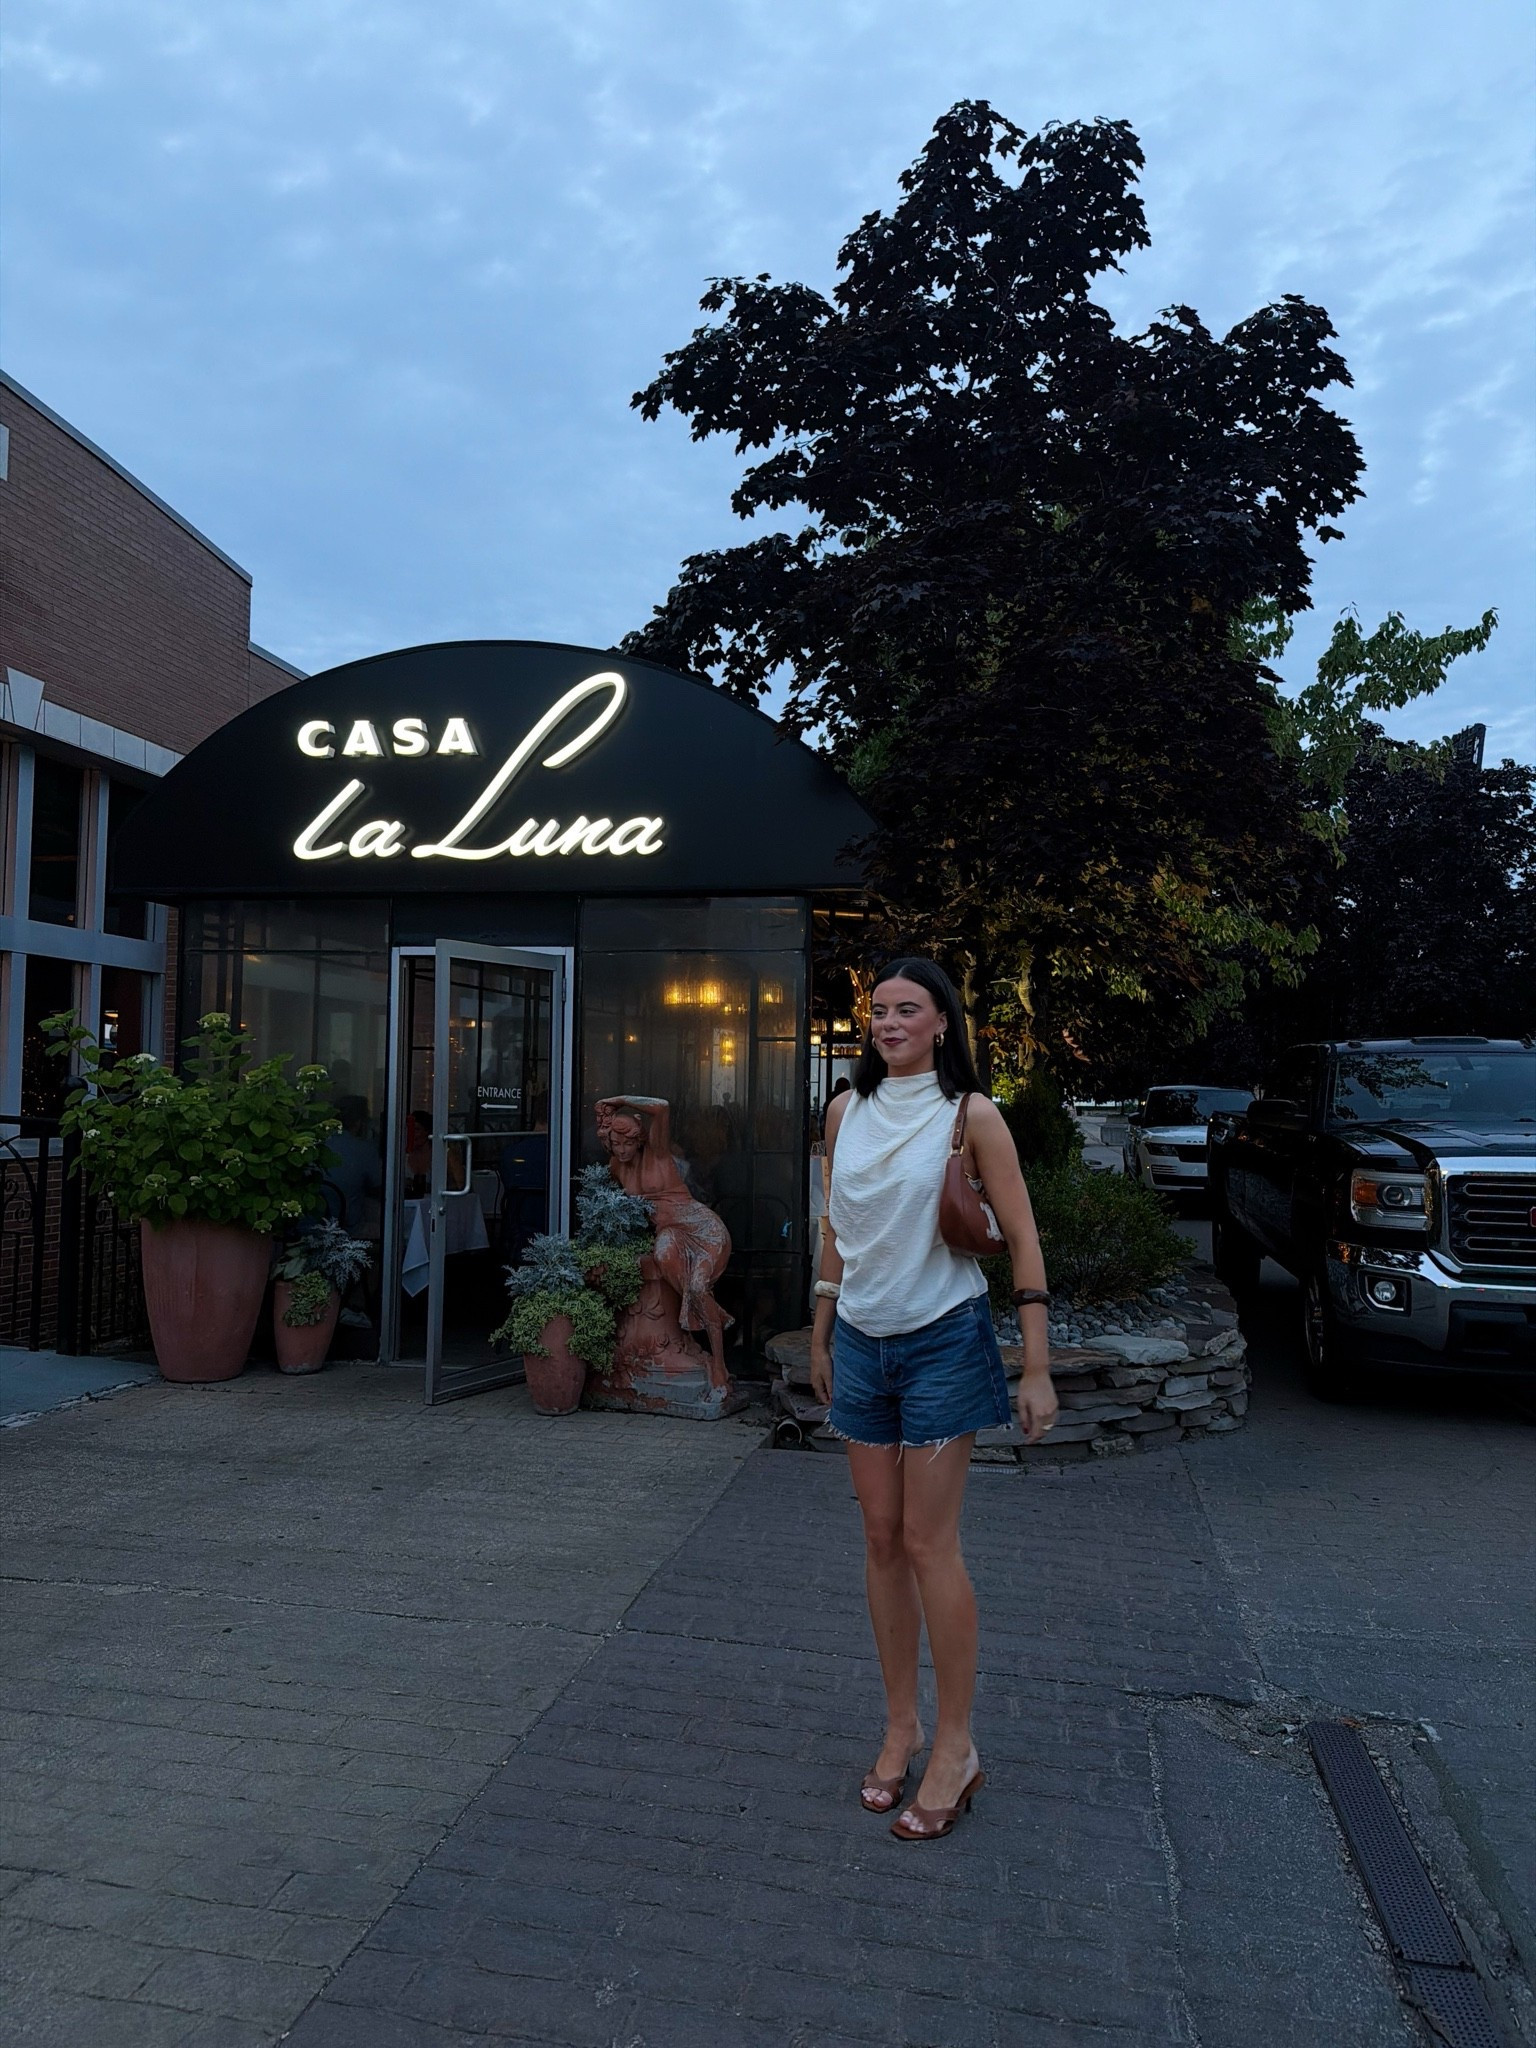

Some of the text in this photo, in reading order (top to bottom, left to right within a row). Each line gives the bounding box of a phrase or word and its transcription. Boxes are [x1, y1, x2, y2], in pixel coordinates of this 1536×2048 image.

[297, 717, 479, 758] CASA
[293, 671, 664, 860] La Luna
[477, 1086, 521, 1099] ENTRANCE
